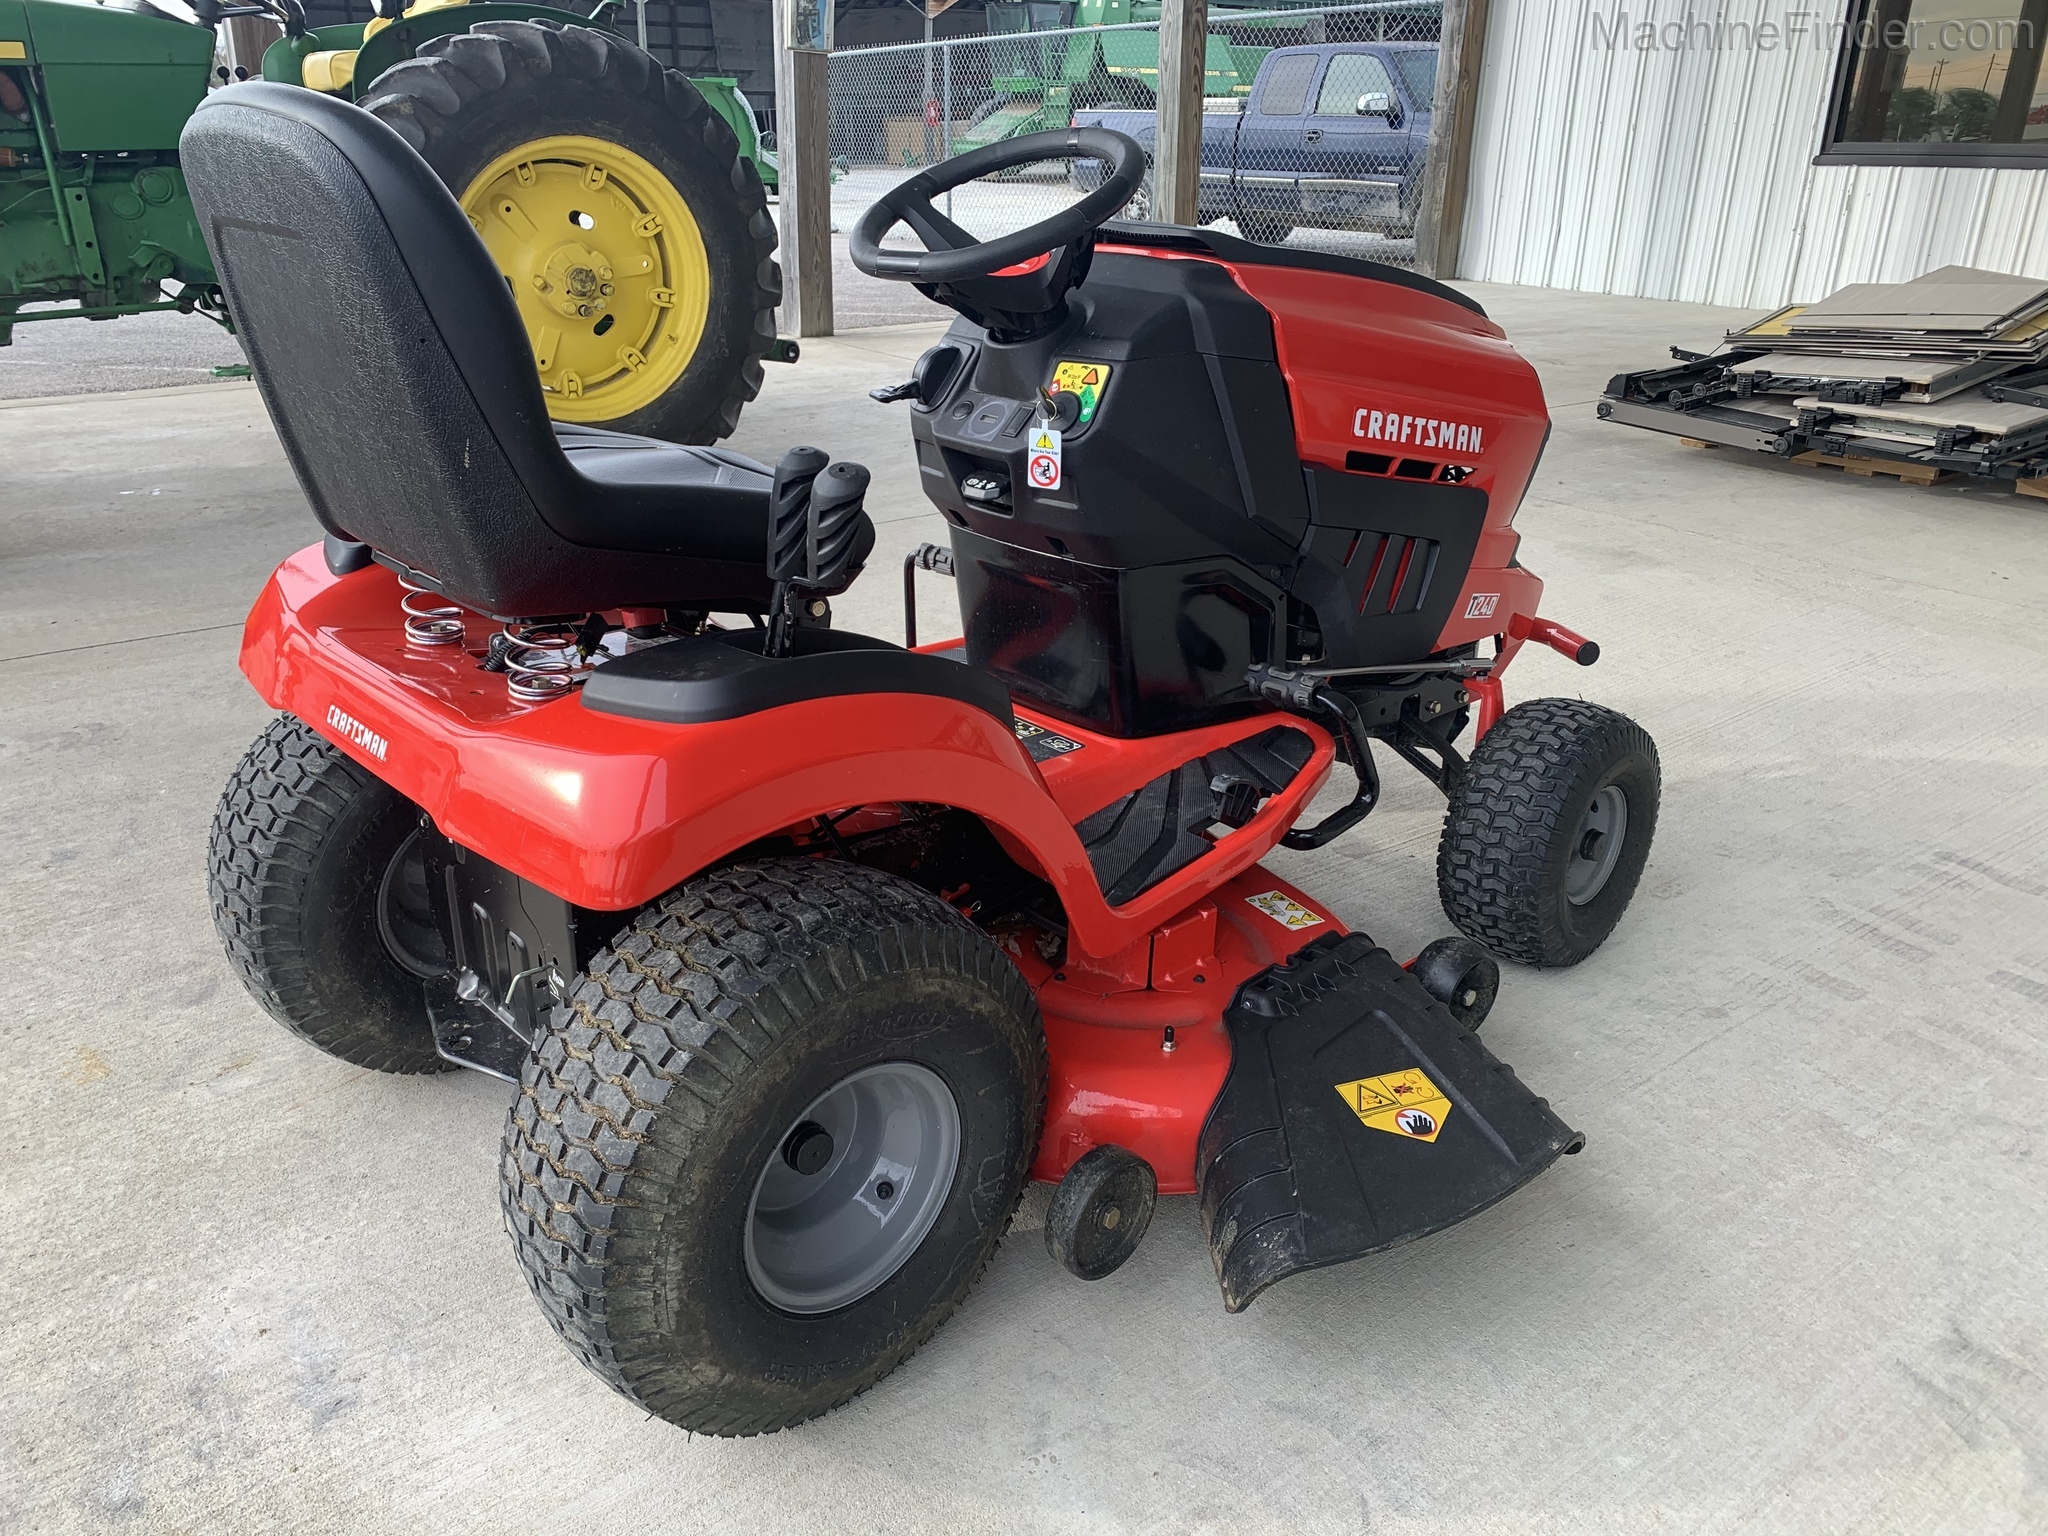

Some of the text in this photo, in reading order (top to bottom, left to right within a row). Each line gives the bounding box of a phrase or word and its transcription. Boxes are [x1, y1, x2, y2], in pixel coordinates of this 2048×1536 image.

[1353, 408, 1484, 453] CRAFTSMAN
[1467, 595, 1498, 615] T240
[326, 704, 388, 761] CRAFTSMAN
